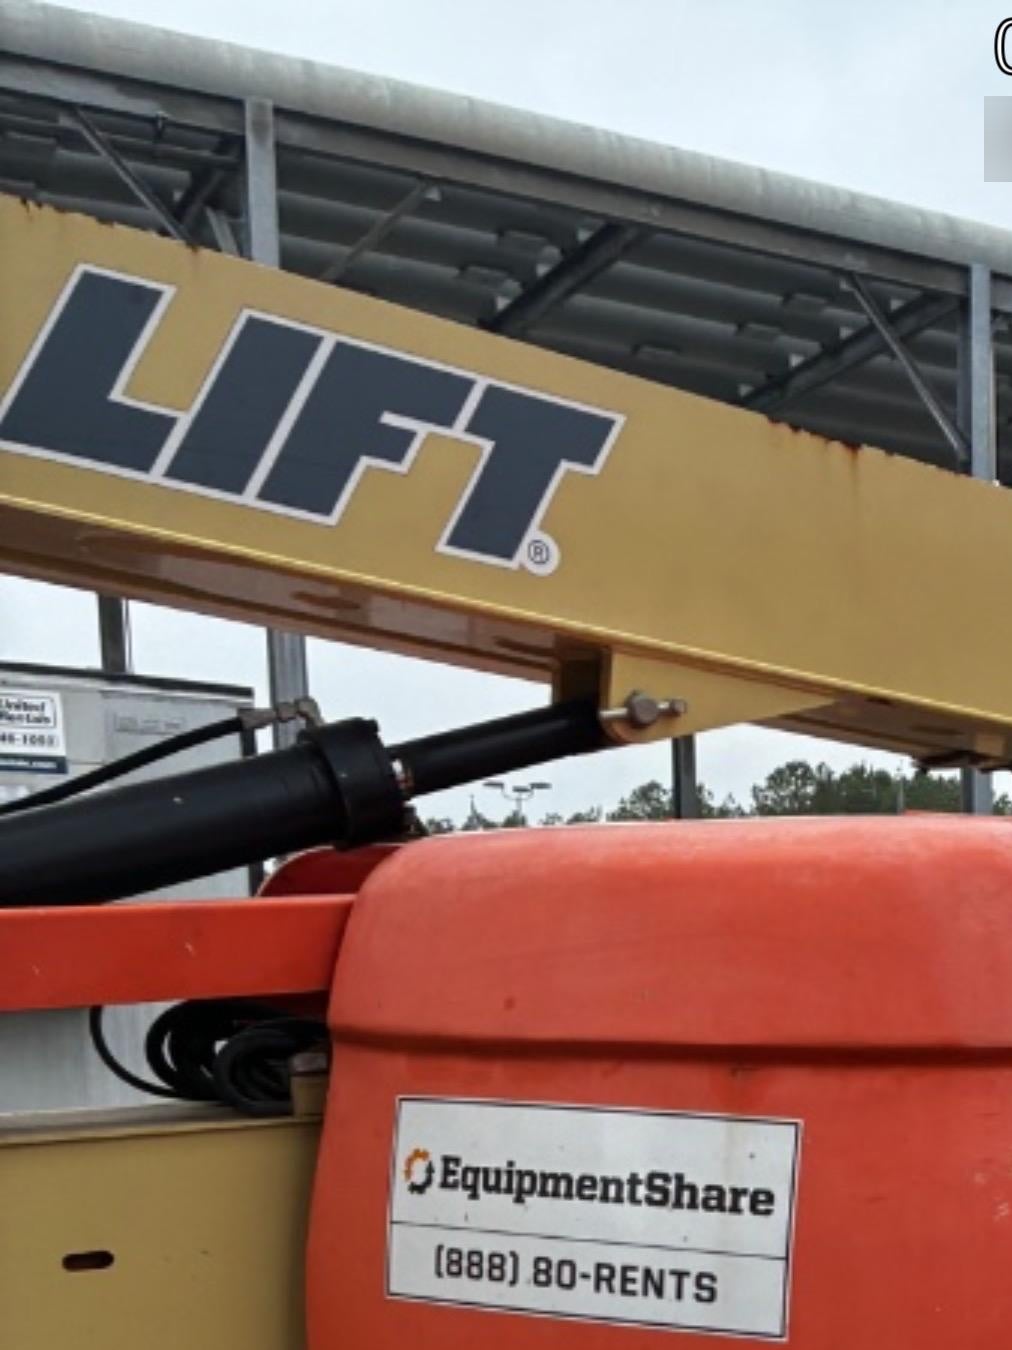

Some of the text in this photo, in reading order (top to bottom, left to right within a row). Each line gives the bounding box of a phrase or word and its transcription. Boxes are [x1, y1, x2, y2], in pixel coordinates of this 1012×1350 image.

[438, 1153, 776, 1217] EquipmentShare
[434, 1244, 719, 1304] (888) 80-RENTS
